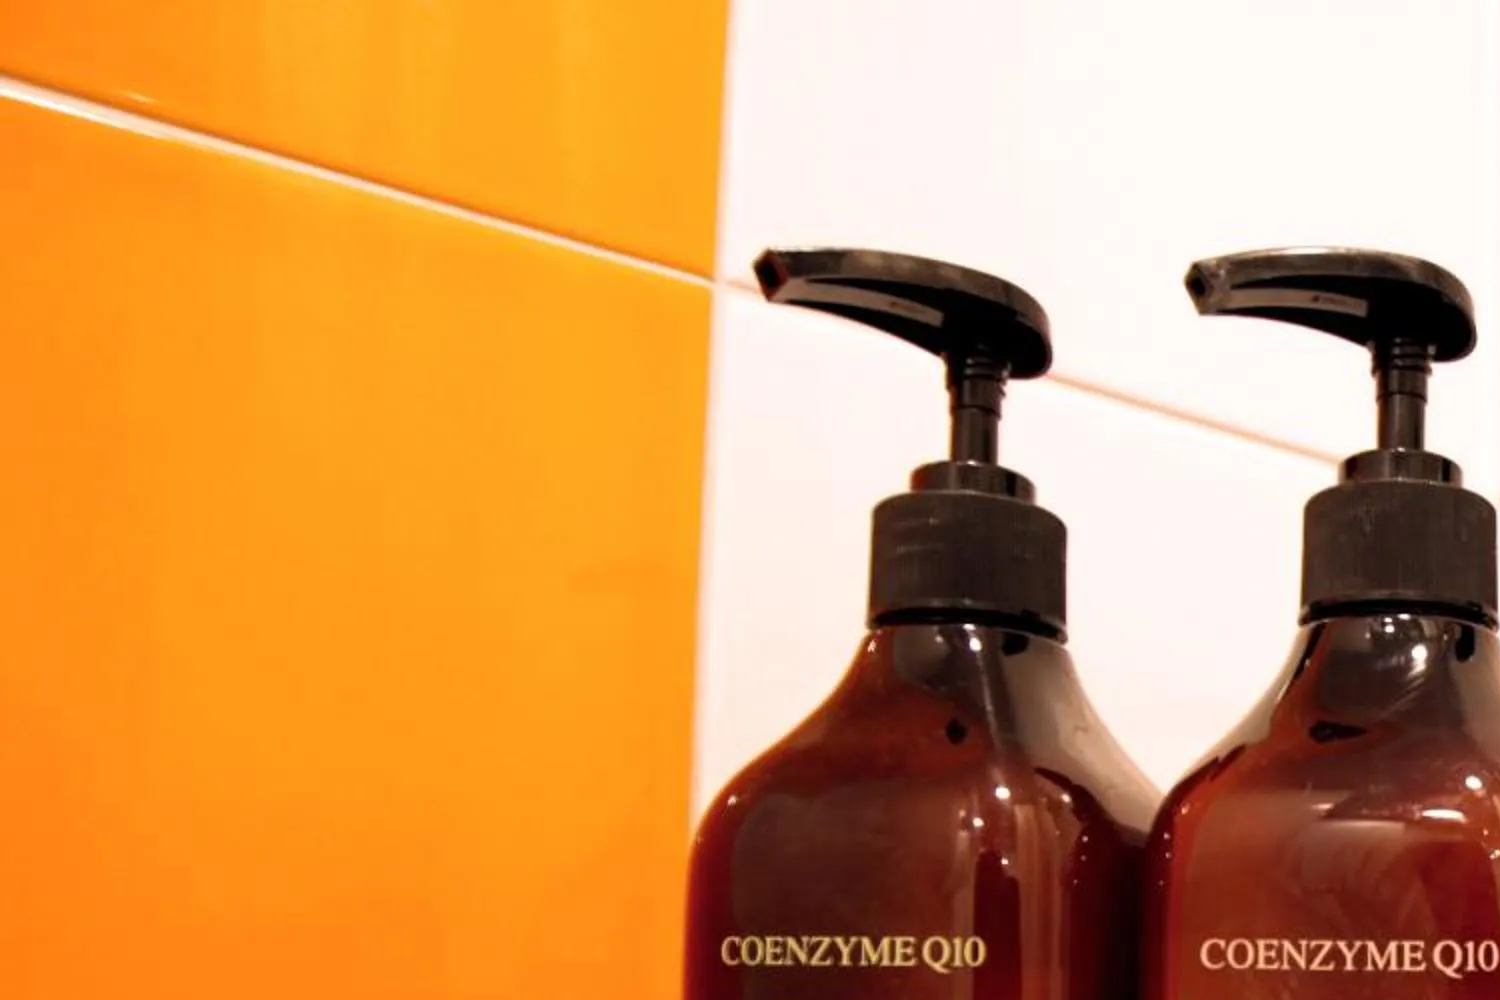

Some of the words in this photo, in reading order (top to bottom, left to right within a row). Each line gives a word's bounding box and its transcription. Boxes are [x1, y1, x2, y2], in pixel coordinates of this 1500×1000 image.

[721, 936, 918, 967] COENZYME
[922, 936, 987, 974] Q10
[1200, 938, 1426, 972] COENZYME
[1433, 940, 1500, 979] Q10
